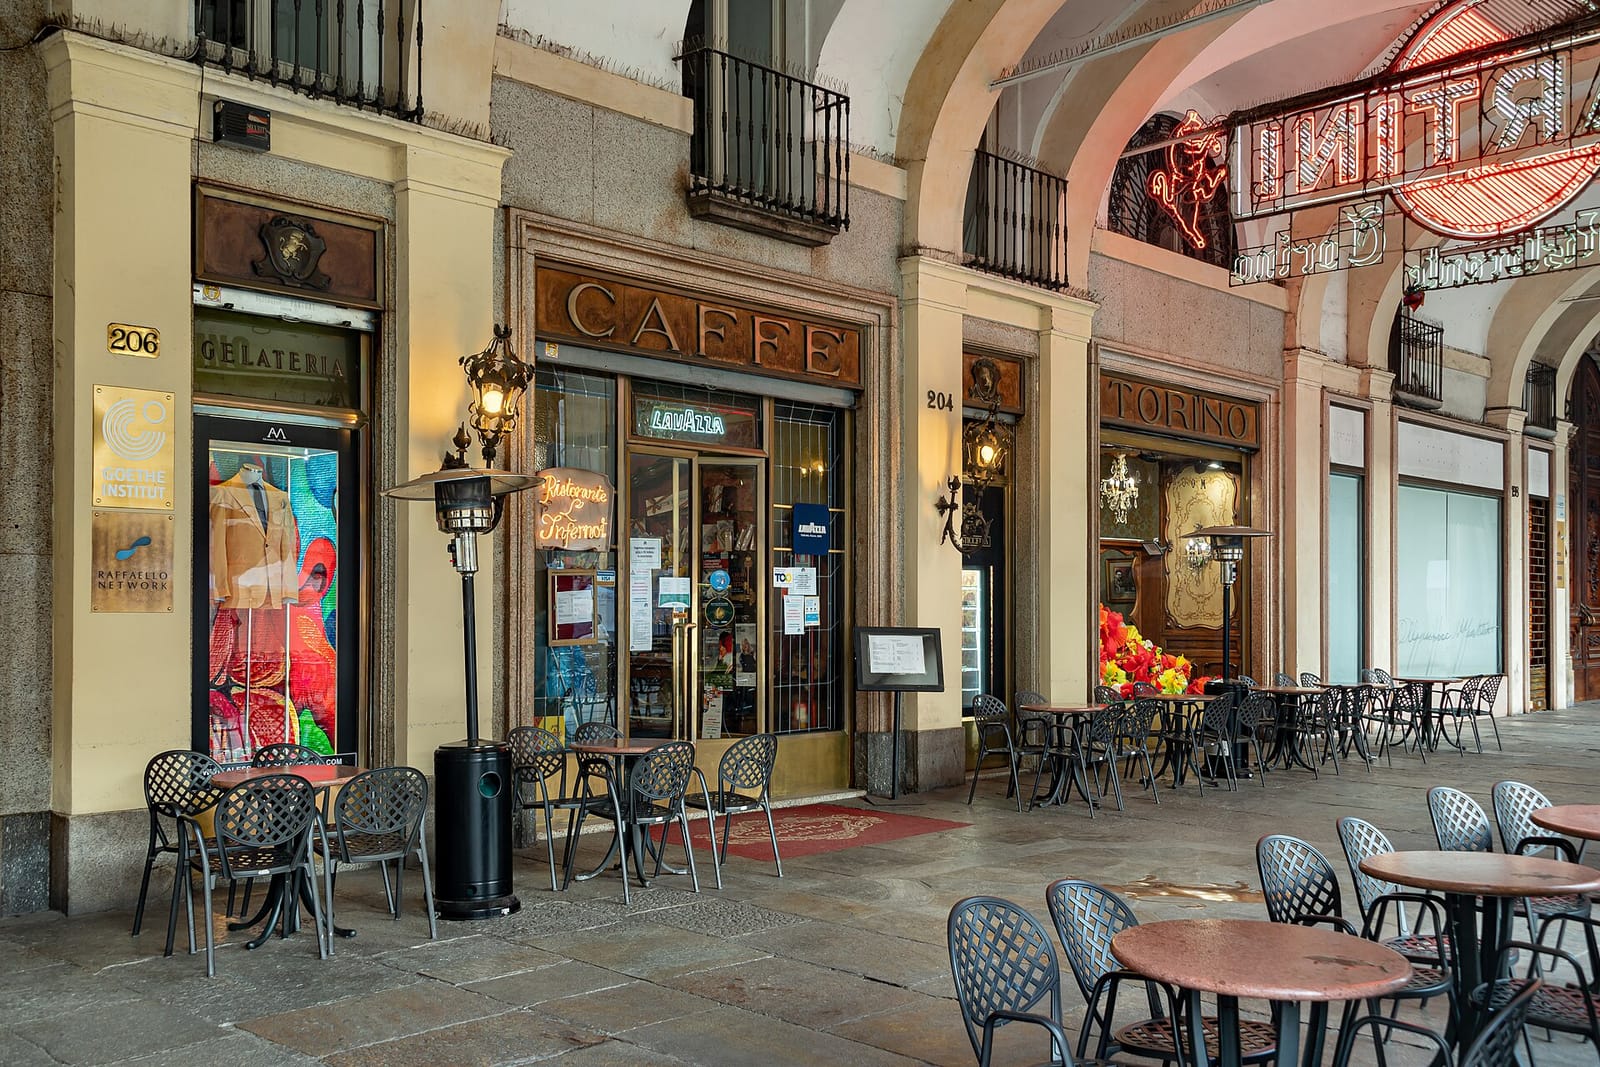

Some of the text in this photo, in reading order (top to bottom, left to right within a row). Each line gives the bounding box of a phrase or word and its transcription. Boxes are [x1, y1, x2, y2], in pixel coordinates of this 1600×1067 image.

[110, 328, 158, 354] 206
[201, 339, 344, 378] GELATERIA
[926, 389, 953, 412] 204
[1108, 379, 1248, 440] TORINO
[652, 408, 726, 435] LAVAZZA
[102, 466, 166, 484] GOETHE
[101, 483, 167, 500] INSTITUT
[538, 474, 608, 504] Ristorante
[97, 581, 168, 590] NETWORK
[98, 570, 168, 580] RAFFAELLO
